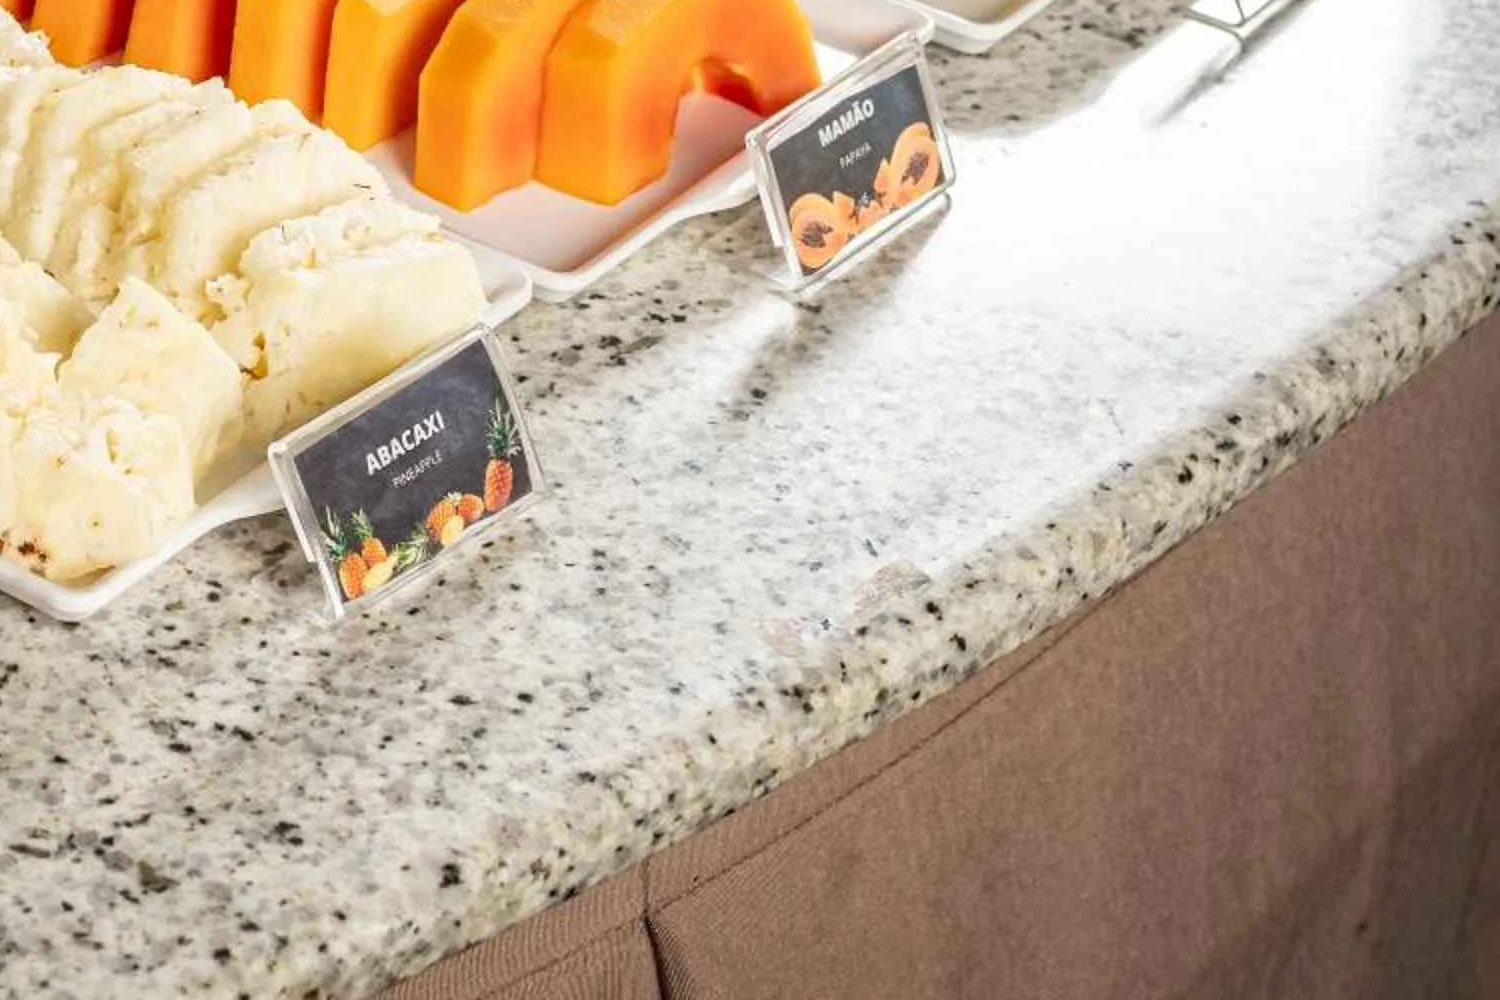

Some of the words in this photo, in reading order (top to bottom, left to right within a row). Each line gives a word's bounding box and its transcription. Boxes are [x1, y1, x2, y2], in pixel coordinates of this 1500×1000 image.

[818, 98, 876, 147] MAMÃO
[364, 409, 447, 476] ABACAXI
[391, 449, 444, 489] PINEAPPLE
